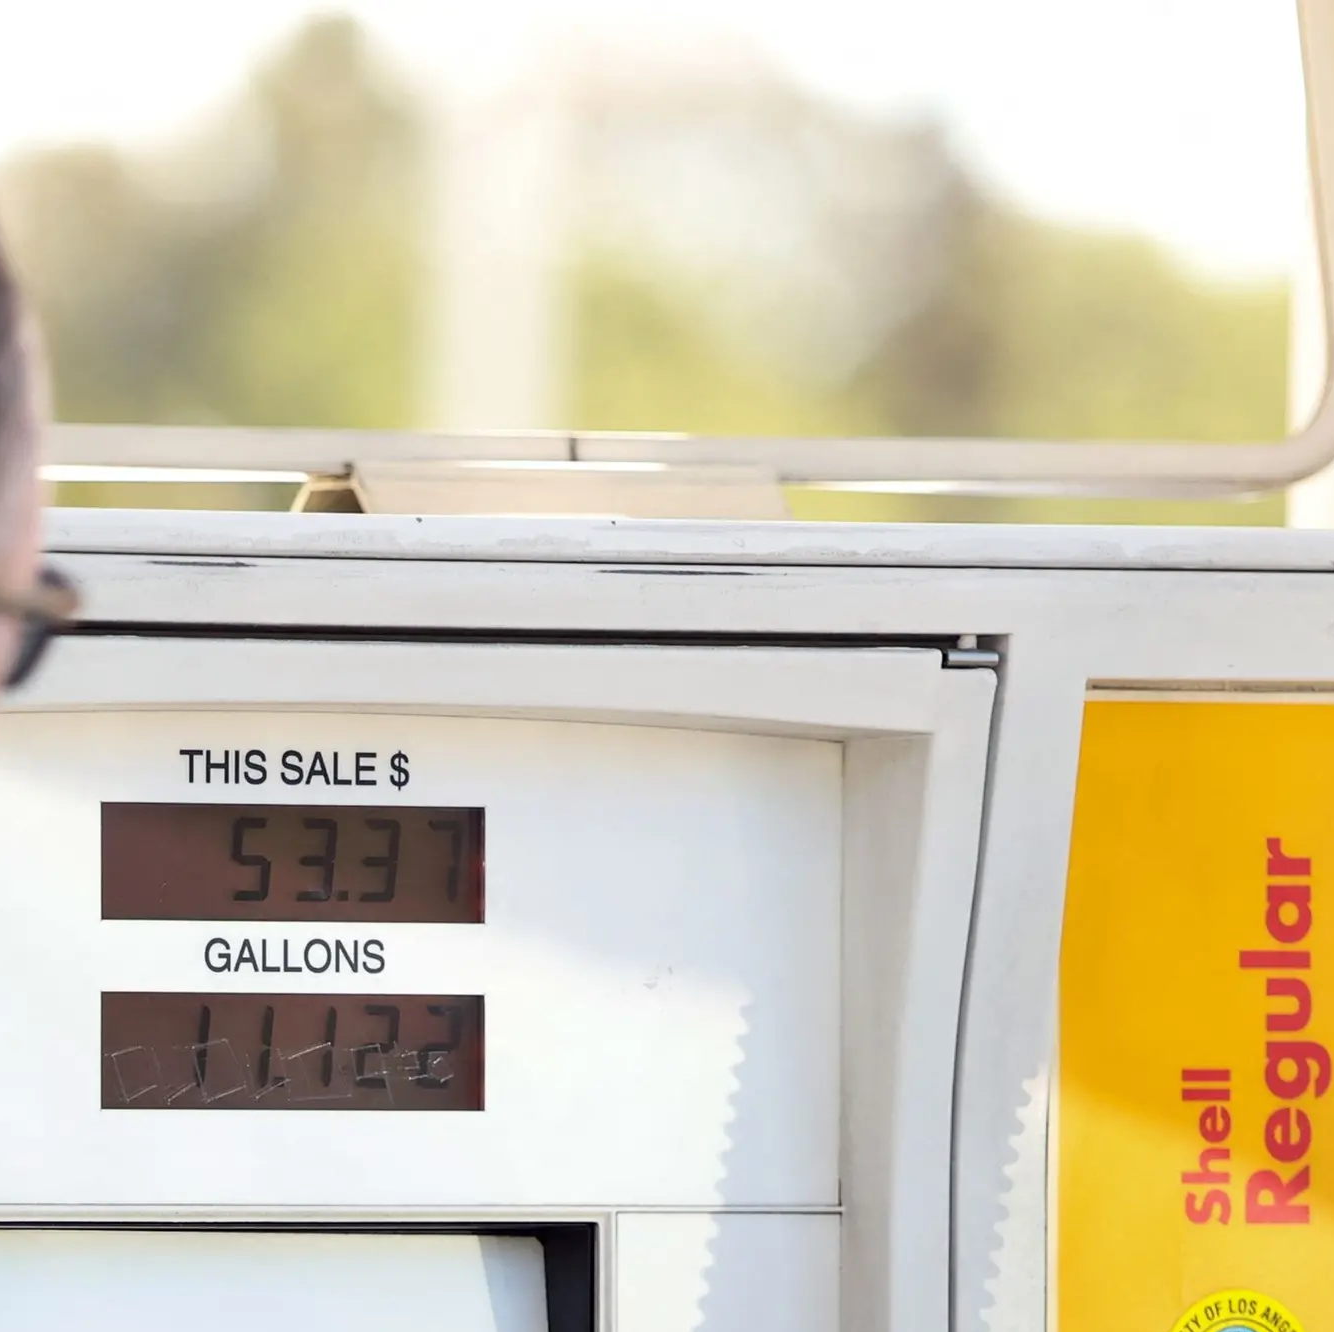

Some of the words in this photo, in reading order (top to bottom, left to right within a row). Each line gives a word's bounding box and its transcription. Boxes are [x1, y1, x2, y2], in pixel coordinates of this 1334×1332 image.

[180, 749, 267, 786] THIS
[280, 751, 378, 787] SALE
[388, 750, 411, 790] $
[230, 817, 463, 903] 53.37
[204, 939, 386, 975] GALLONS
[1239, 837, 1332, 1225] Regular
[1181, 1068, 1232, 1225] Shell
[1203, 1299, 1223, 1322] OF
[1228, 1298, 1258, 1317] LOS
